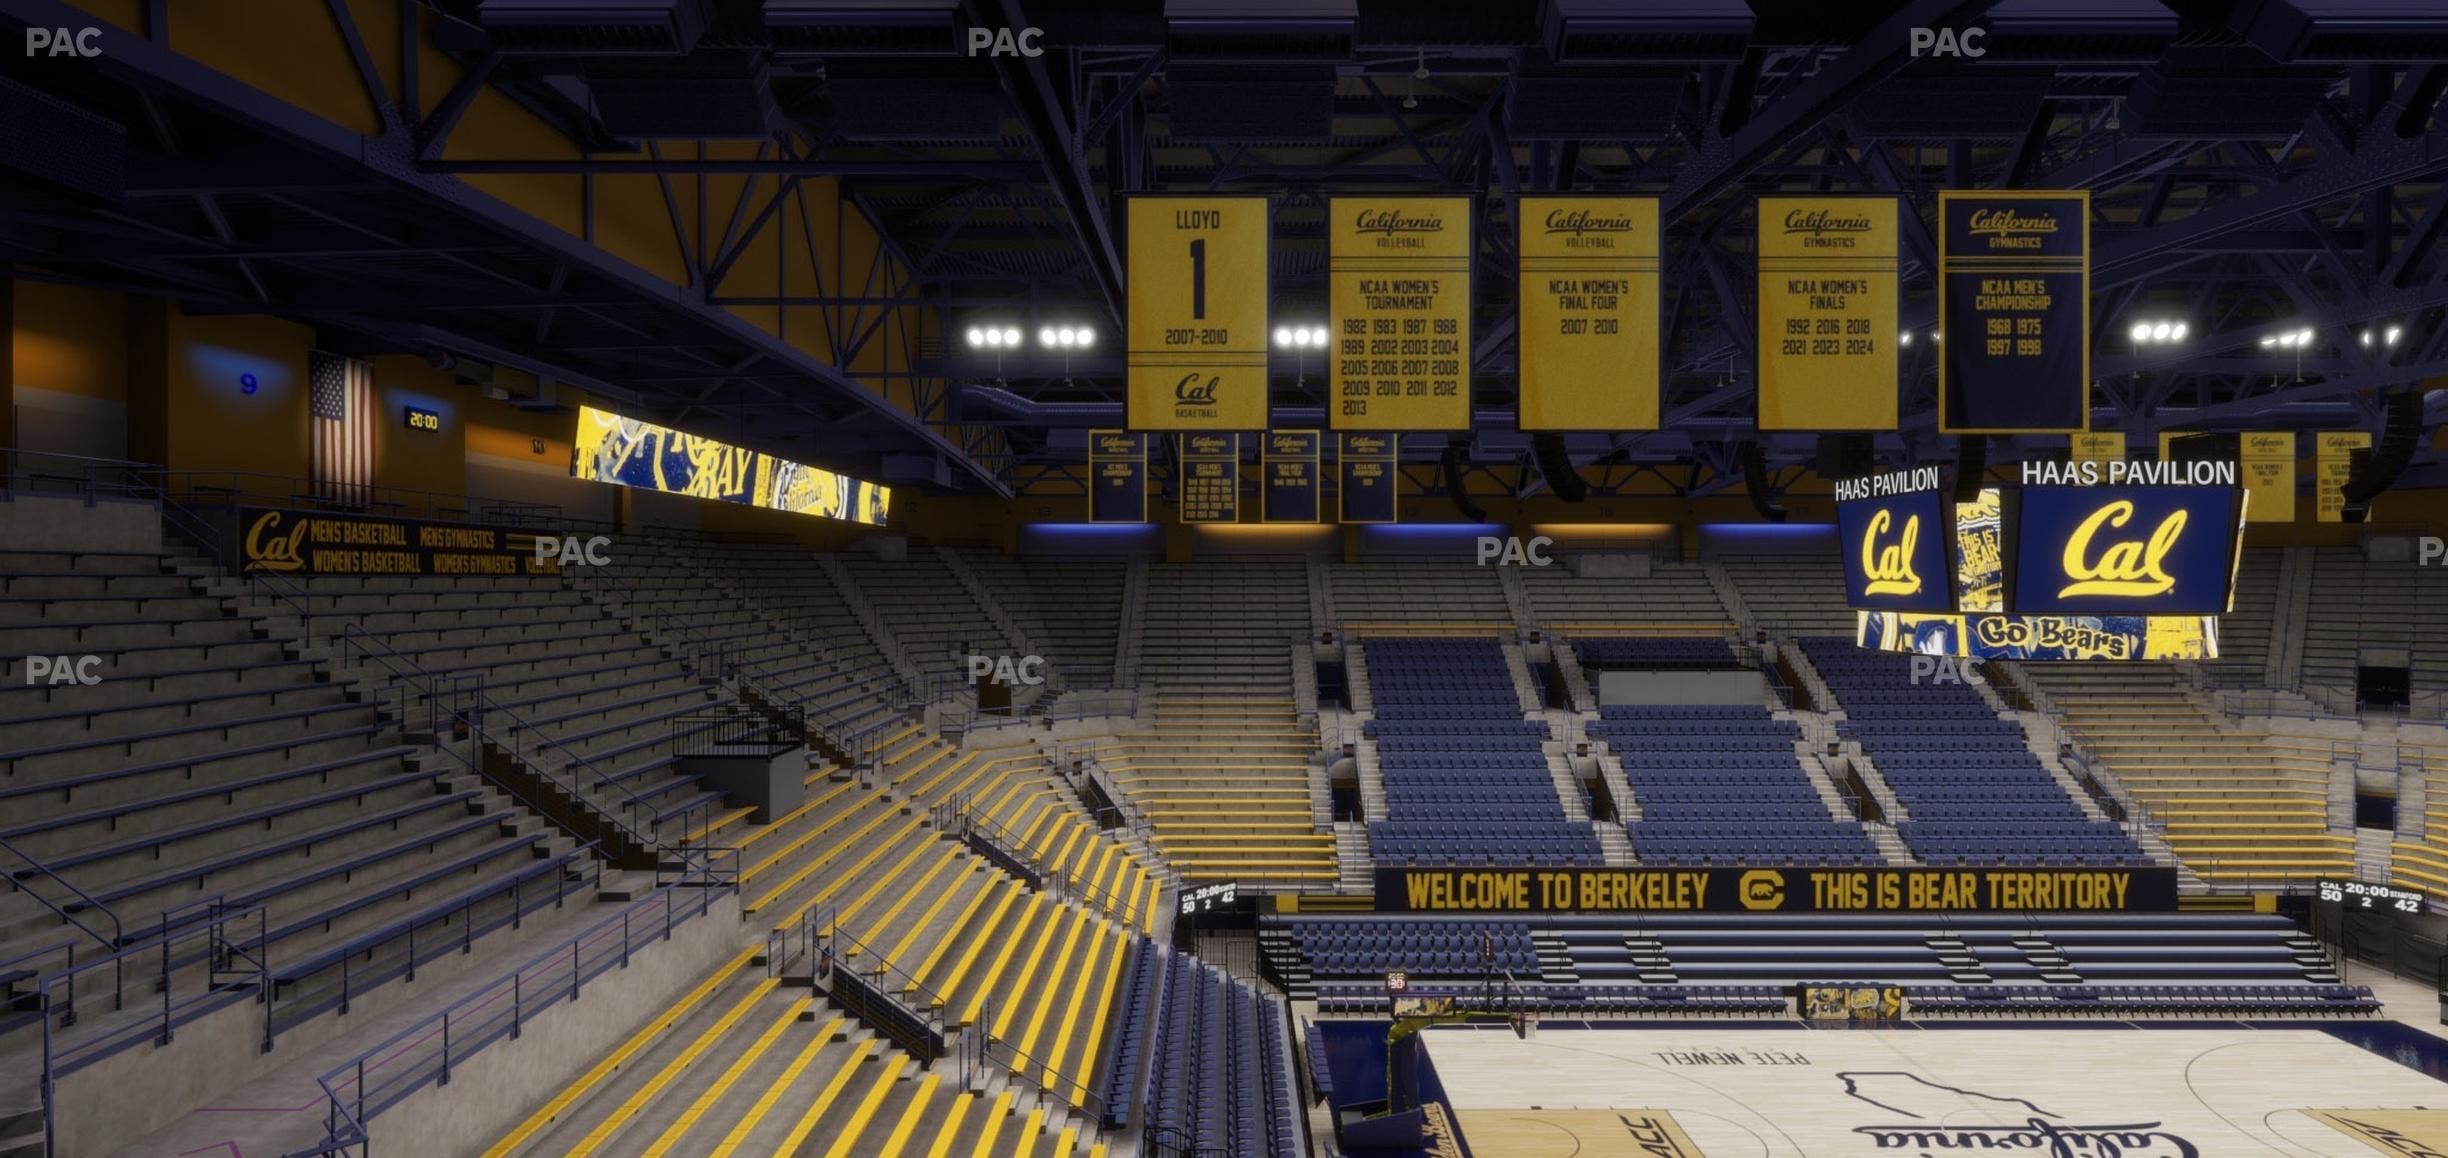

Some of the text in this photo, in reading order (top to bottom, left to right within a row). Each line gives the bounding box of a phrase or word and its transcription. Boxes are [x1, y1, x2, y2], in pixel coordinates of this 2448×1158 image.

[1176, 210, 1221, 229] LLOYD
[1355, 208, 1445, 236] California
[1545, 208, 1633, 236] California
[1783, 208, 1872, 236] California
[1968, 208, 2059, 236] California
[1376, 238, 1425, 248] VOLLEYBALL
[1566, 238, 1615, 248] VOLLEYBALL
[1804, 237, 1855, 248] GYMNASTICS
[1989, 237, 2043, 248] GYMNASTICS
[1190, 238, 1205, 320] 1
[1359, 280, 1440, 294] NCAA WOMEN'S
[1549, 280, 1629, 294] NCAA WOMEN'S
[1788, 280, 1868, 294] NCAA WOMEN'S
[1981, 279, 2045, 294] NCAA MEN'S
[1365, 295, 1433, 311] TOURNAMENT
[1560, 296, 1618, 310] FINAL FOUR
[1810, 295, 1846, 310] FINALS
[1975, 295, 2052, 311] CHAMPIONSHIP
[1342, 318, 1367, 335] 1982
[1373, 318, 1397, 335] 1983
[1403, 318, 1427, 335] 1987
[1561, 319, 1618, 335] 2007 2010
[1786, 319, 1870, 335] 1992 2016 2018
[2017, 318, 2042, 335] 1975
[1165, 328, 1228, 346] 2007-2010
[1341, 339, 1459, 355] 1989 2002 2003 2004
[1782, 339, 1874, 355] 2021 2023 2024
[1986, 338, 2012, 355] 1997
[1341, 360, 1459, 376] 2005 2006 2007 2008
[240, 373, 257, 394] 9
[1174, 372, 1221, 406] Cal
[1342, 380, 1457, 396] 2009 2010 2011 2012
[1175, 409, 1218, 419] BASKETBALL
[1342, 400, 1367, 415] 2013
[410, 411, 438, 430] 20:00
[2022, 460, 2099, 486] HAAS
[2109, 460, 2235, 486] PAVILION
[1835, 465, 1939, 502] HAAS PAVILION
[344, 521, 407, 546] BASKETBALL
[445, 528, 495, 550] GYMNASTICS
[244, 511, 308, 573] Cal
[2057, 499, 2189, 600] Cal
[1862, 508, 1921, 596] Cal
[361, 551, 421, 574] BASKETBALL
[469, 554, 516, 574] GYMNASTICS
[1980, 616, 2126, 657] Go Bears
[1196, 885, 1219, 900] 20:00
[1405, 872, 1710, 910] WELCOME TO BERKELEY
[1810, 872, 2130, 909] THIS IS BEAR TERRITORY
[2320, 882, 2343, 891] CAL
[2345, 882, 2389, 898] 20:00
[1222, 891, 1235, 903] 42
[2320, 890, 2343, 902] 50
[2361, 897, 2372, 908] 2
[1182, 901, 1195, 914] 50
[1205, 899, 1211, 910] 2
[2394, 899, 2419, 913] 42
[1650, 1052, 1812, 1065] PETE NEWELL
[1851, 1118, 2200, 1158] California
